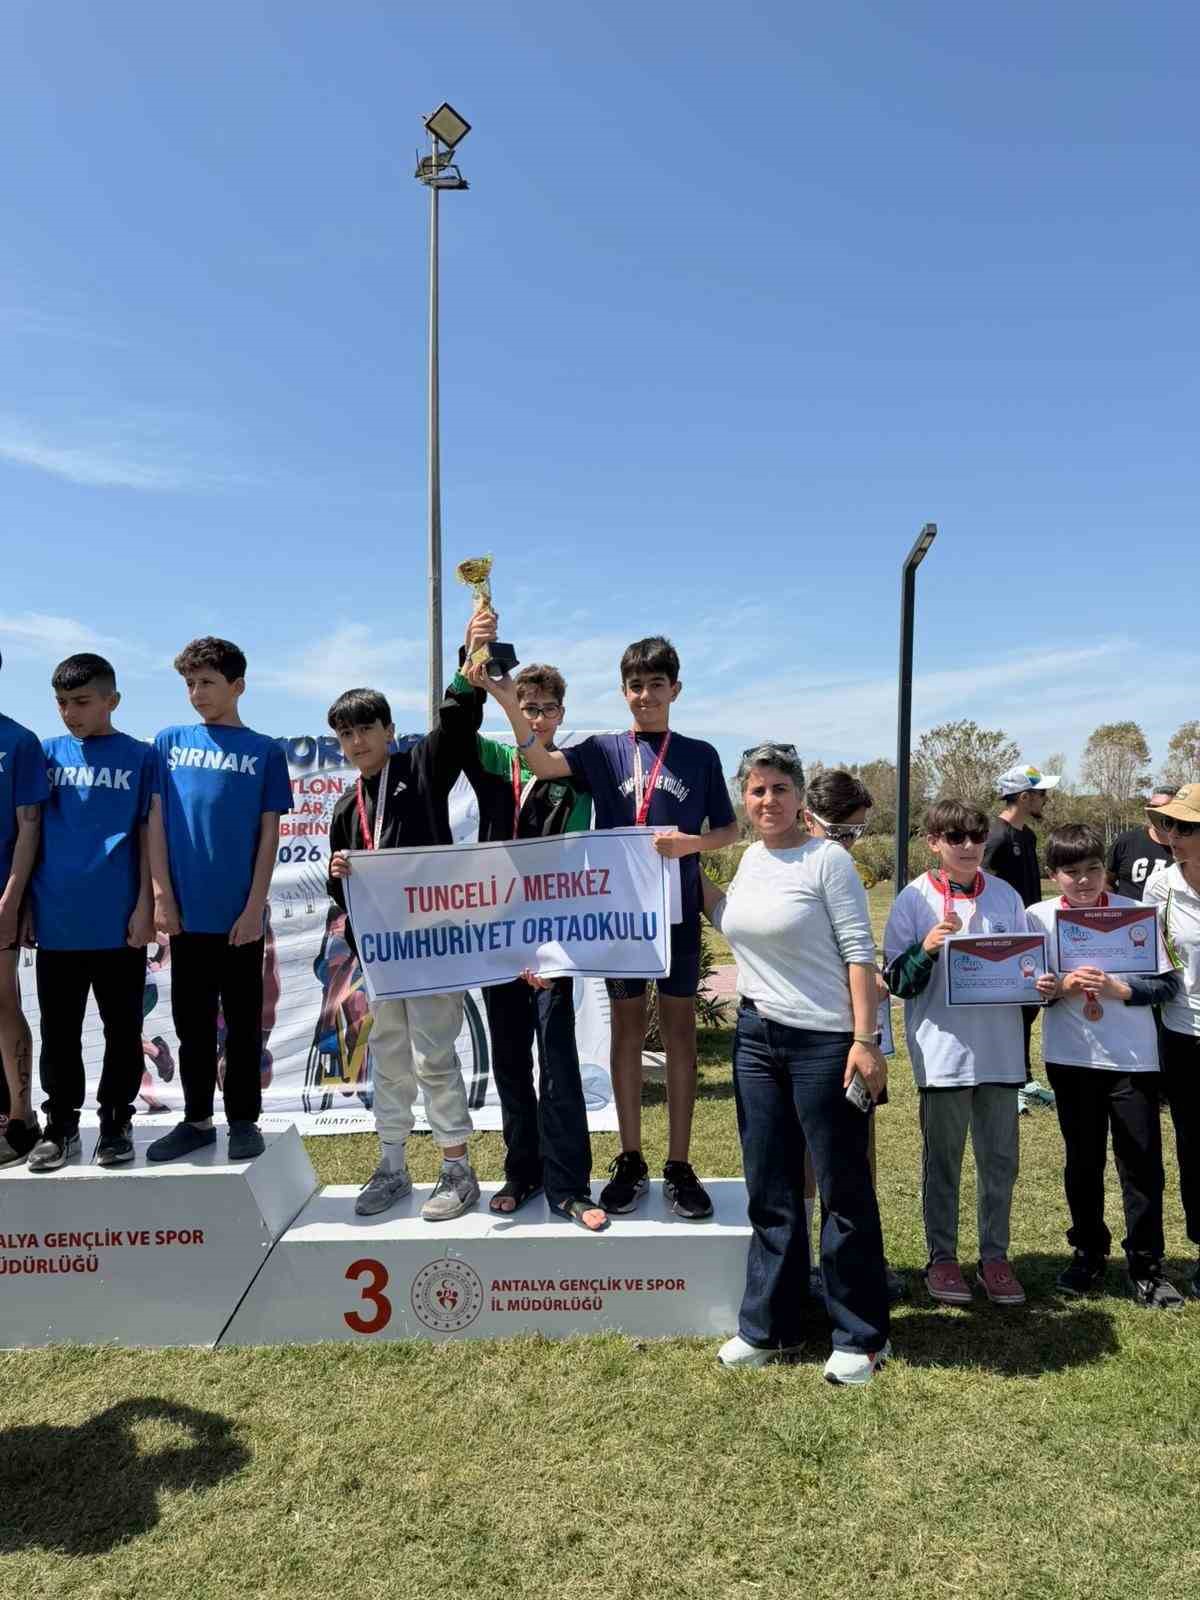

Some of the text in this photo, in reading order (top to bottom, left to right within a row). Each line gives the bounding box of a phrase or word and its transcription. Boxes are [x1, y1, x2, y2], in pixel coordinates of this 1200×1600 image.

[167, 746, 259, 776] ŞIRNAK
[278, 845, 322, 863] 026
[404, 868, 611, 913] TUNCELİ / MERKEZ
[361, 911, 657, 964] CUMHURİYET ORTAOKULU
[44, 1228, 122, 1251] GENÇLİK
[127, 1230, 150, 1246] VE
[155, 1229, 204, 1245] SPOR
[343, 1258, 392, 1334] 3
[491, 1276, 686, 1294] ANTALYA GENÇLİK VE SPOR
[491, 1295, 603, 1311] İL MÜDÜRLÜĞÜ
